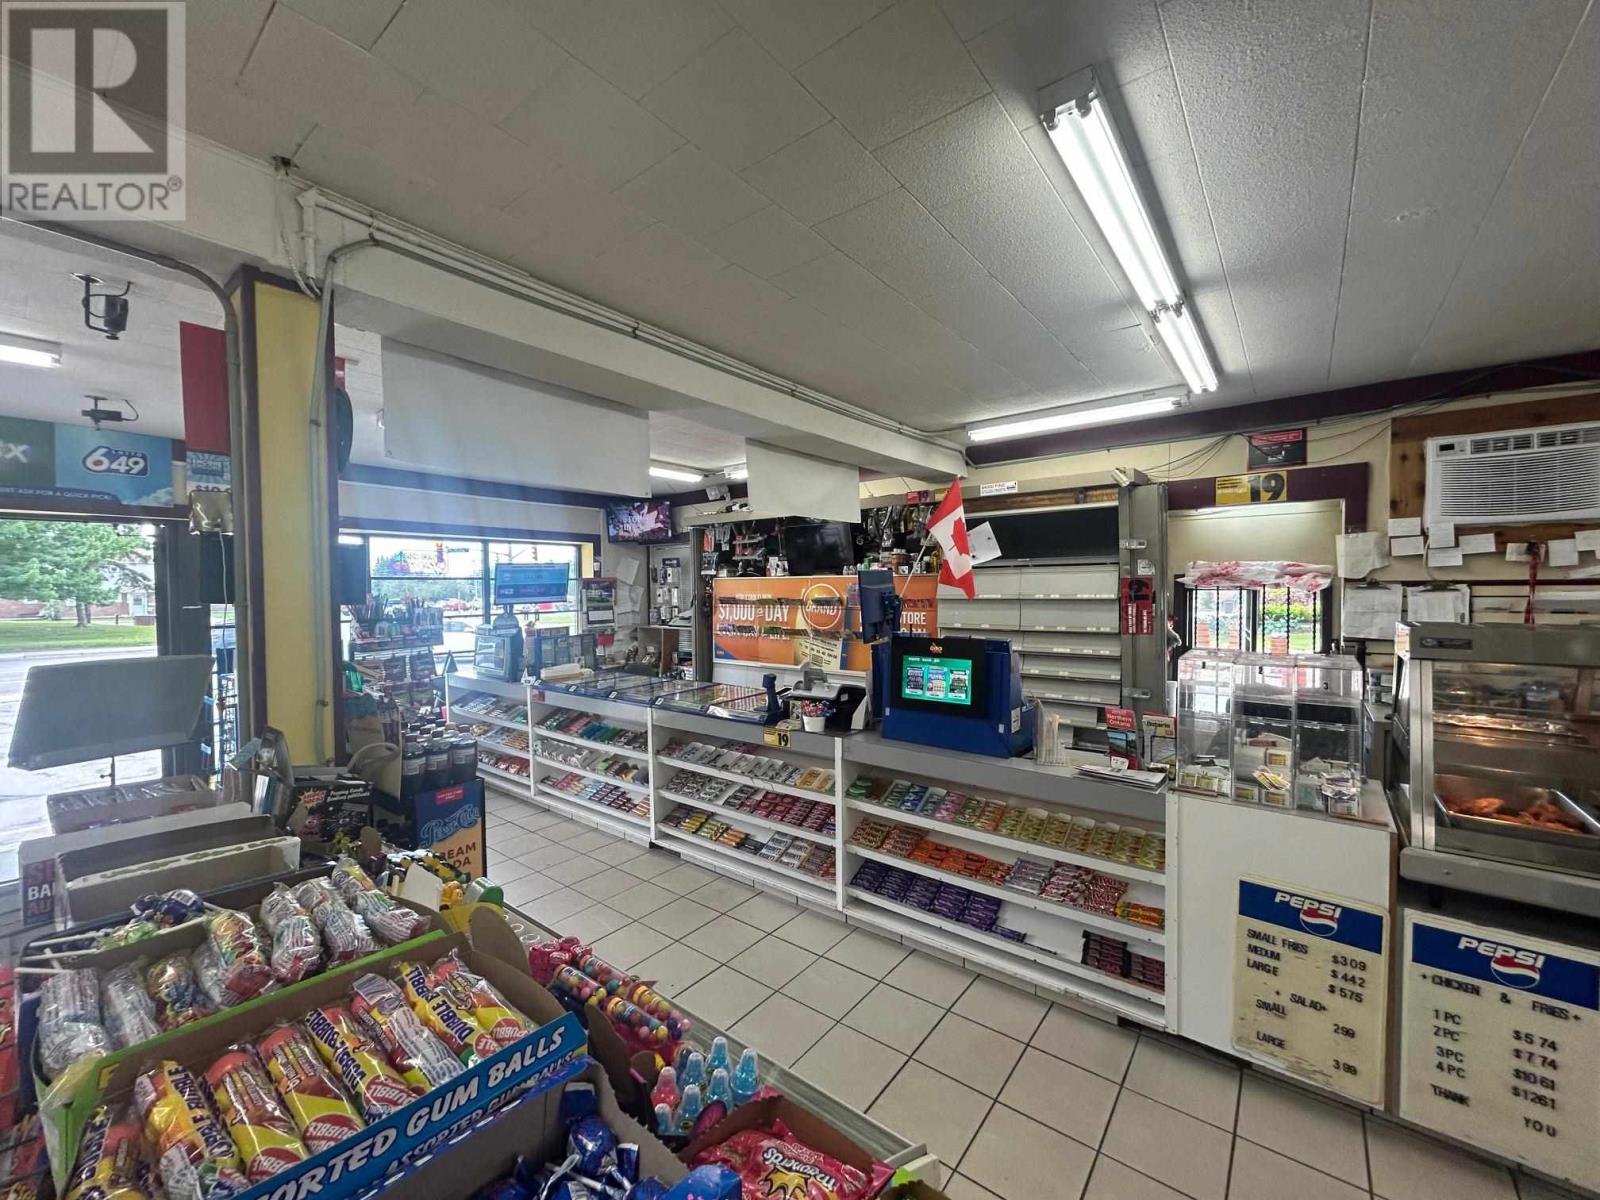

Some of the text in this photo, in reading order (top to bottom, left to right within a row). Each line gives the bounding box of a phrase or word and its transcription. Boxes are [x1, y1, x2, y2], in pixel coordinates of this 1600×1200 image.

[0, 441, 30, 464] X
[1250, 473, 1285, 502] 19
[901, 611, 927, 625] TORE
[777, 733, 789, 746] 19
[440, 842, 476, 861] REAM
[453, 856, 472, 869] DA
[1274, 891, 1342, 919] PEPSI
[1246, 928, 1309, 955] SMALL FRIES
[1457, 936, 1546, 969] PEPSI
[1246, 958, 1280, 977] LARGE
[1431, 974, 1481, 997] CHICKEN
[1531, 1000, 1571, 1021] FRIES
[1255, 999, 1287, 1019] SMALL
[1256, 1030, 1287, 1050] LARGE
[254, 1027, 565, 1200] ORTED GUM BALLS
[1523, 1116, 1557, 1138] YOU
